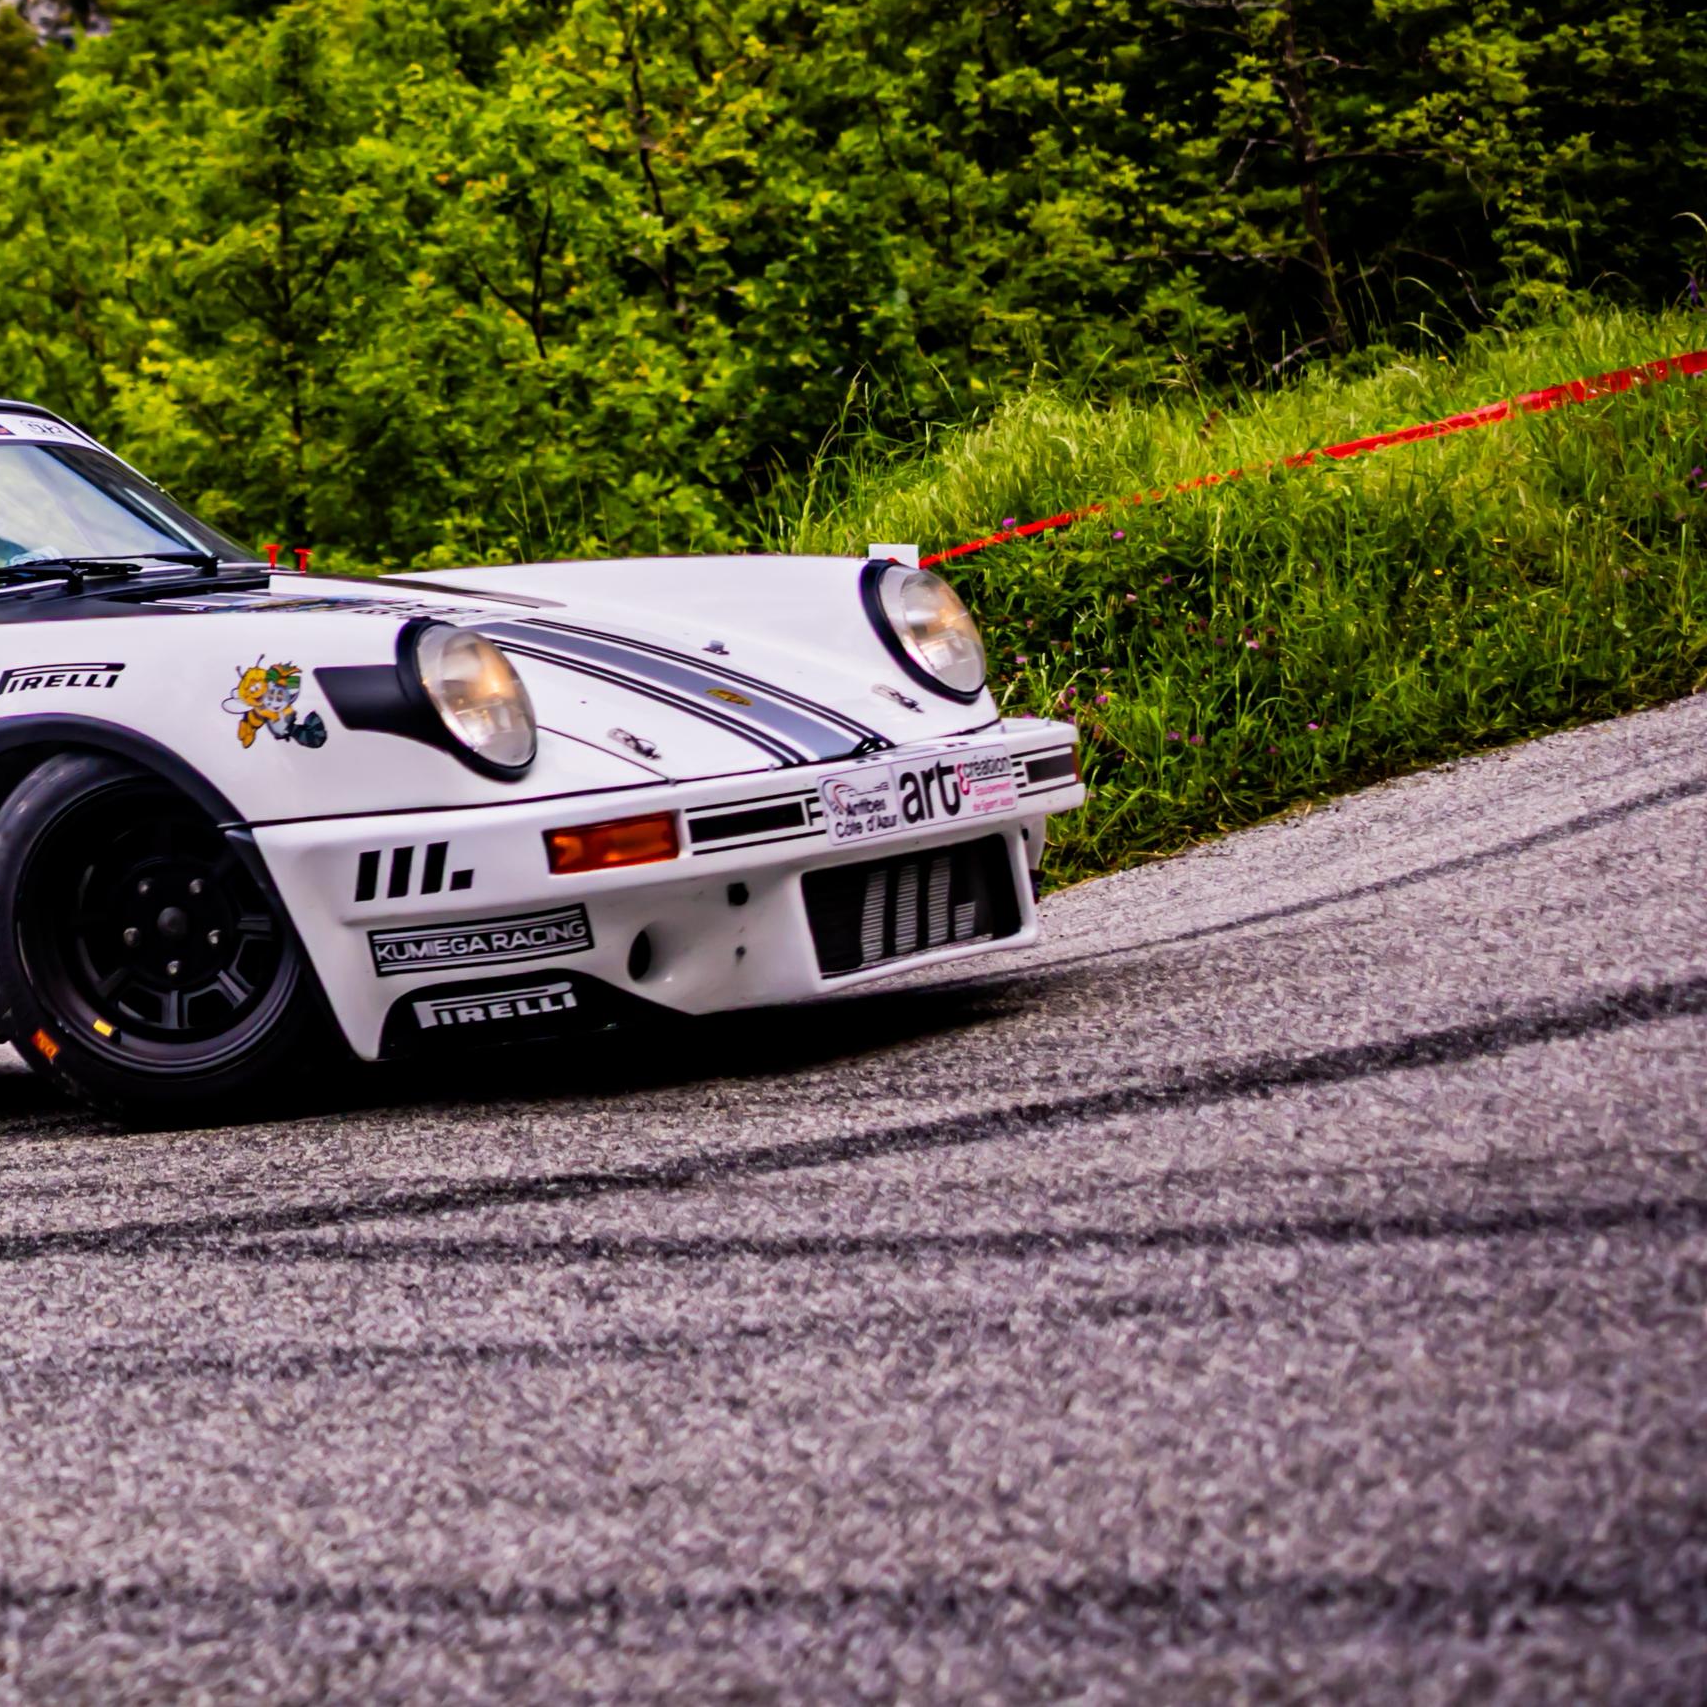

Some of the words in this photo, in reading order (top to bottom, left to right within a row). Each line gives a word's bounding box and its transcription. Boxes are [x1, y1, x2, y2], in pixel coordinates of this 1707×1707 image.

[899, 760, 961, 824] art
[375, 936, 489, 962] KUMIEGA
[491, 919, 587, 952] RACING
[412, 981, 578, 1030] PIRELLI
